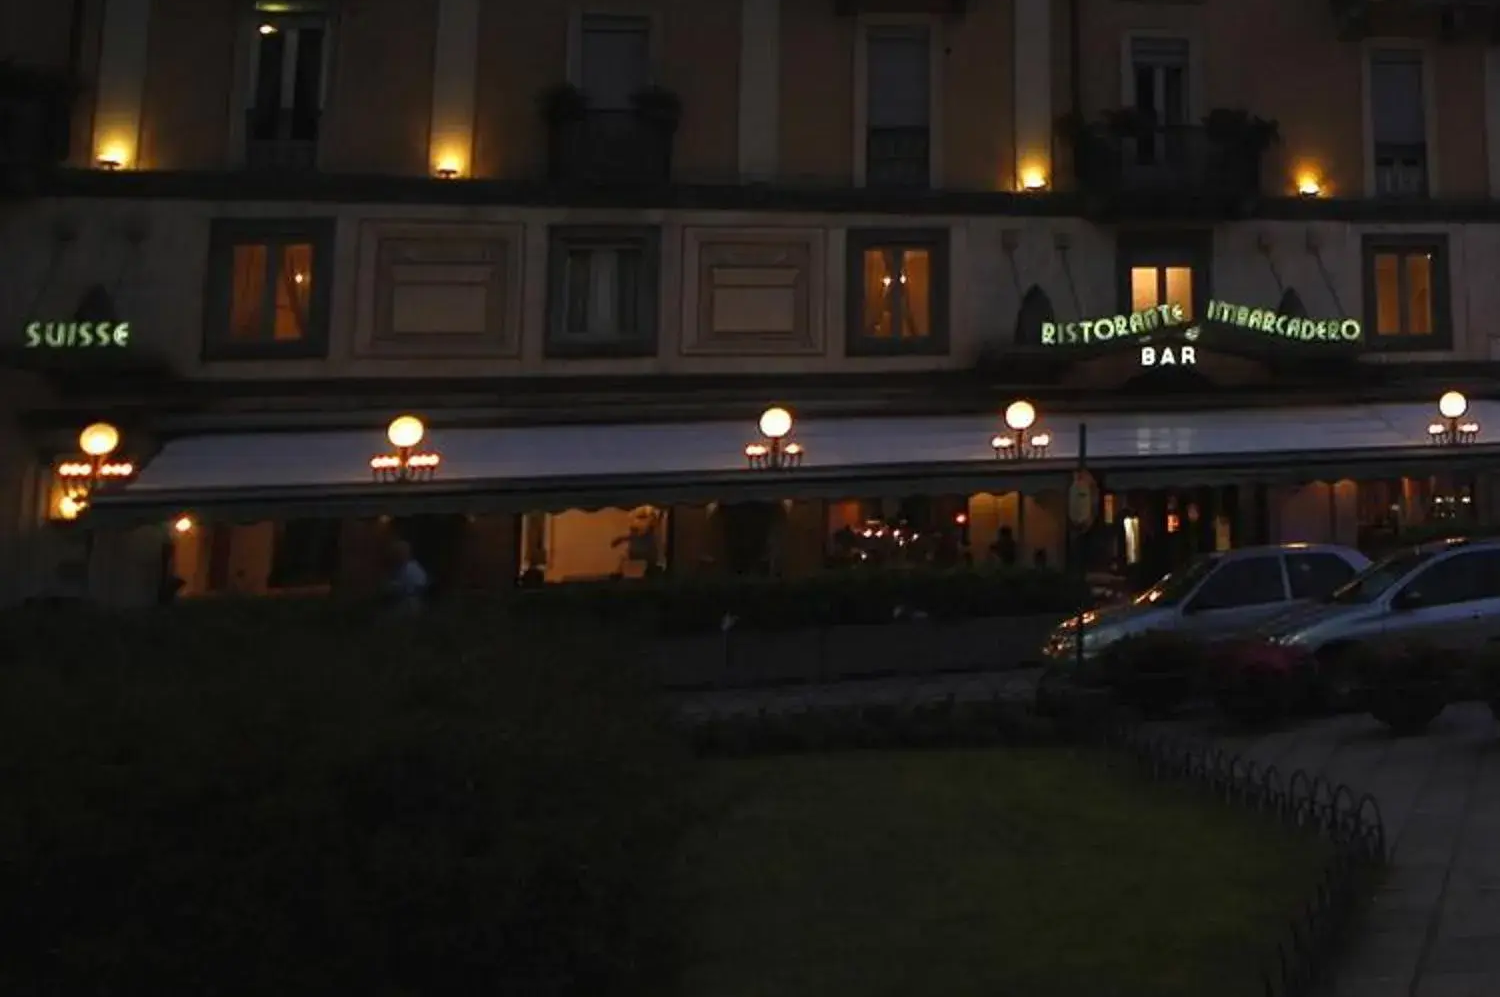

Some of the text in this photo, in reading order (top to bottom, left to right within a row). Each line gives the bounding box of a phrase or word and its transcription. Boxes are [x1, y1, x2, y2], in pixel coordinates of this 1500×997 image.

[24, 321, 130, 347] SUISSE
[1041, 303, 1184, 344] RISTORANTE
[1207, 299, 1361, 341] IMBARCADERO
[1141, 346, 1196, 366] BAR
